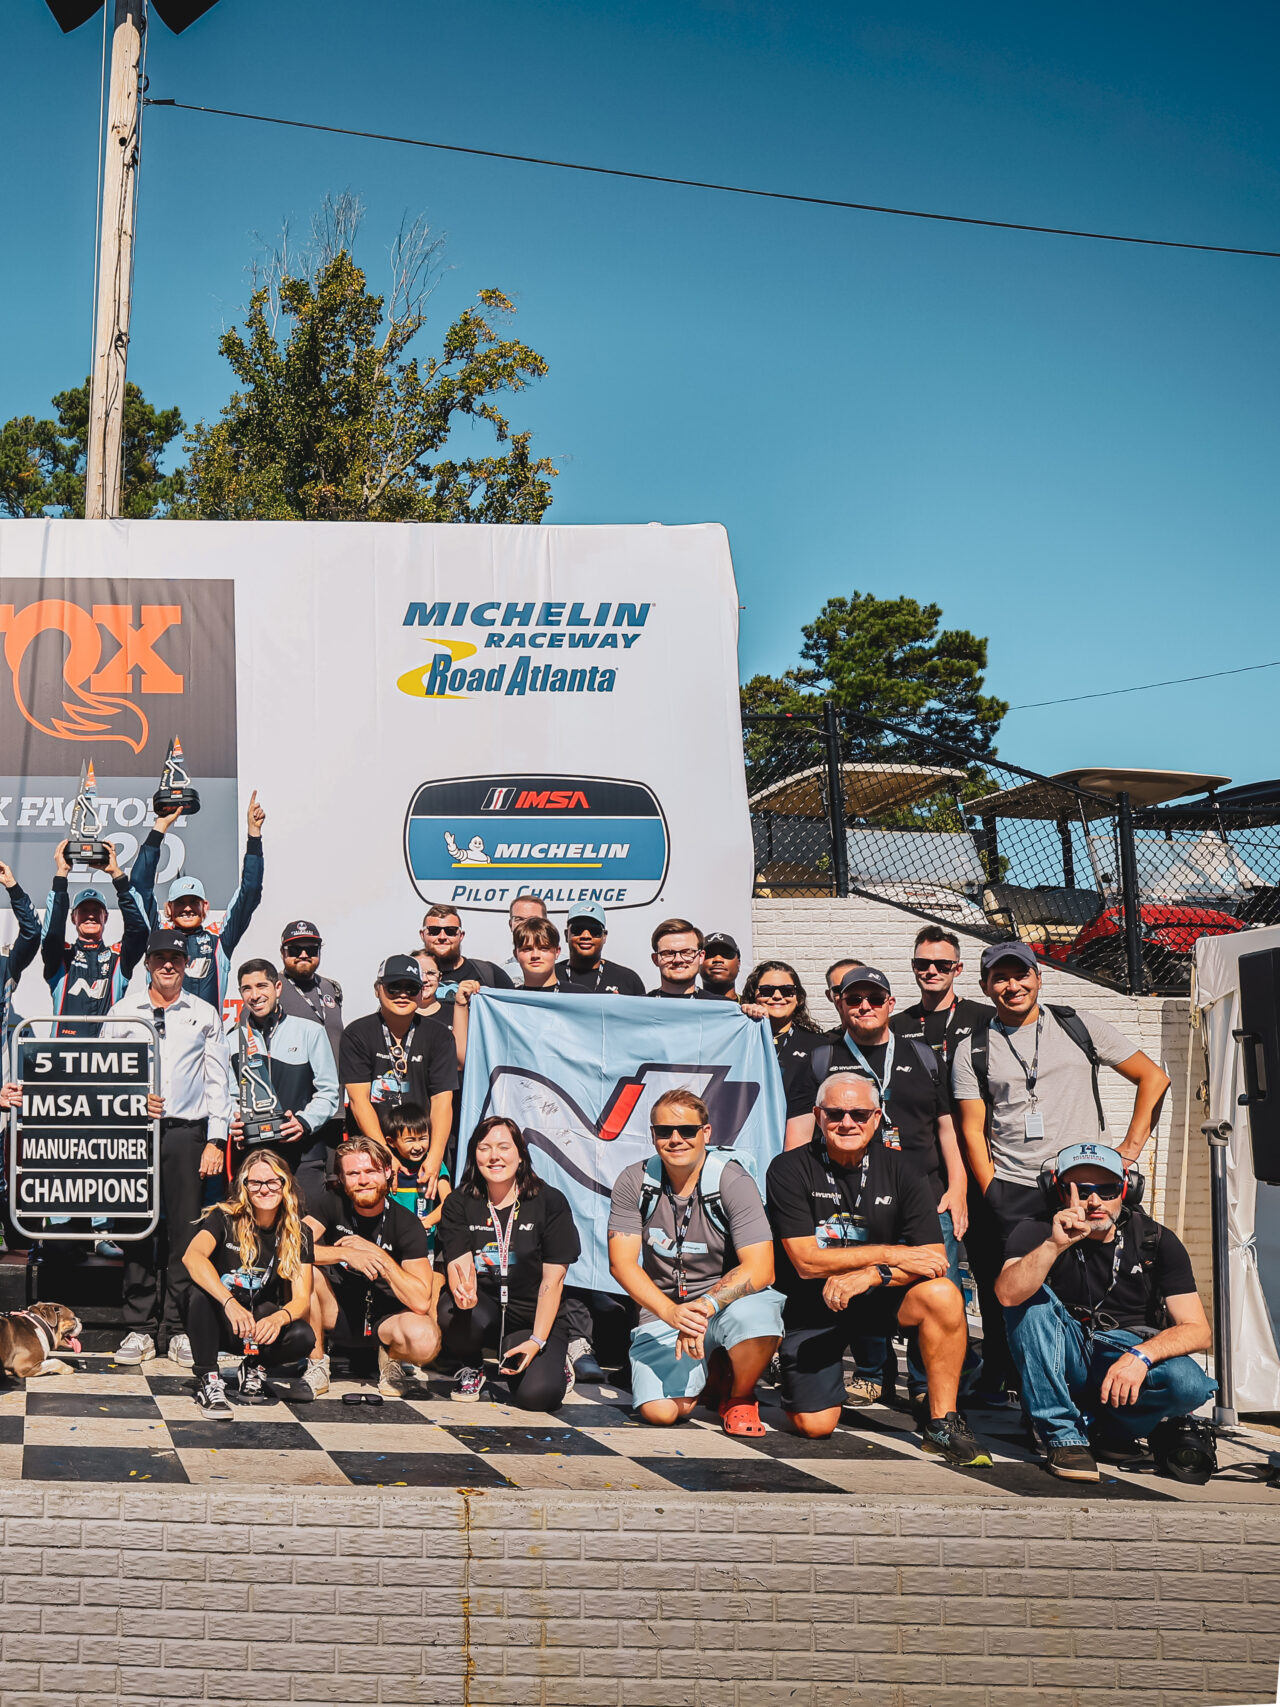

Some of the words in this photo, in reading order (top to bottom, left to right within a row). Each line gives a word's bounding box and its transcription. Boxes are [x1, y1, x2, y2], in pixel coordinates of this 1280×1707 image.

[402, 602, 652, 627] MICHELIN
[484, 633, 641, 649] RACEWAY
[425, 653, 507, 696] Road
[504, 656, 617, 696] Atlanta
[515, 791, 590, 809] IMSA
[494, 843, 631, 859] MICHELIN
[451, 885, 509, 902] PILOT
[34, 1052, 53, 1074] 5
[59, 1052, 139, 1074] TIME
[22, 1094, 92, 1117] IMSA
[97, 1094, 148, 1117] TCR
[22, 1138, 147, 1160] MANUFACTURER
[20, 1178, 149, 1203] CHAMPIONS
